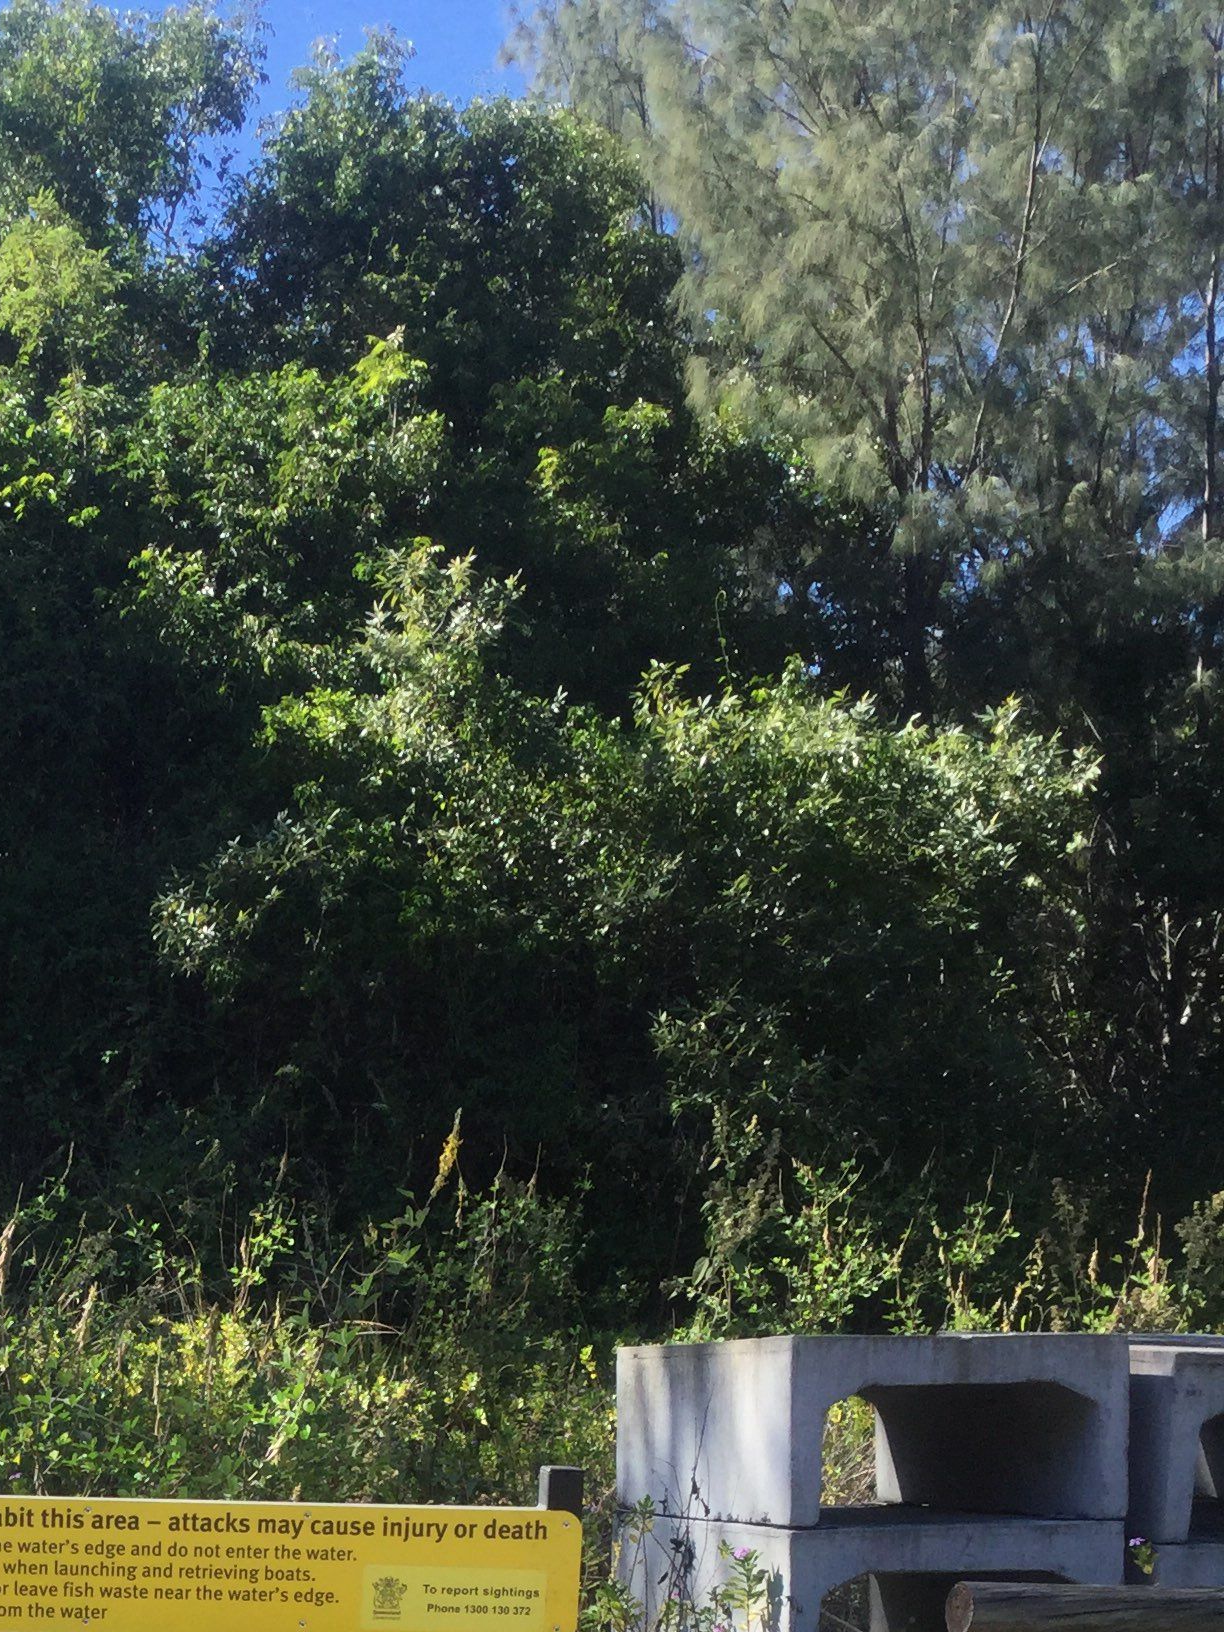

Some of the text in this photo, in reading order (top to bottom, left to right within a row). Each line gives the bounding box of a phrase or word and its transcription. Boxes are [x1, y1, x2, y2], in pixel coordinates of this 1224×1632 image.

[41, 1508, 85, 1529] this
[91, 1512, 140, 1530] area
[168, 1512, 250, 1533] attacks
[257, 1517, 304, 1539] may
[310, 1519, 375, 1536] cause
[382, 1517, 448, 1543] injury
[454, 1522, 478, 1539] or
[484, 1519, 548, 1540] death
[84, 1541, 126, 1559] edge
[130, 1541, 161, 1557] and
[167, 1542, 188, 1557] do
[193, 1544, 221, 1558] not
[225, 1546, 270, 1560] enter
[274, 1545, 301, 1561] the
[306, 1547, 358, 1562] water.
[2, 1560, 48, 1575] when
[54, 1560, 137, 1581] launching
[141, 1563, 173, 1579] and
[178, 1565, 260, 1582] retrieving
[264, 1565, 316, 1582] boats.
[14, 1582, 58, 1598] leave
[62, 1583, 94, 1598] fish
[99, 1584, 149, 1600] waste
[153, 1586, 190, 1600] near
[196, 1586, 223, 1602] the
[294, 1588, 340, 1605] edge.
[423, 1584, 540, 1600] To report sightings
[28, 1601, 56, 1619] the
[60, 1605, 108, 1620] water
[426, 1602, 531, 1616] Phone 1300 130 372
